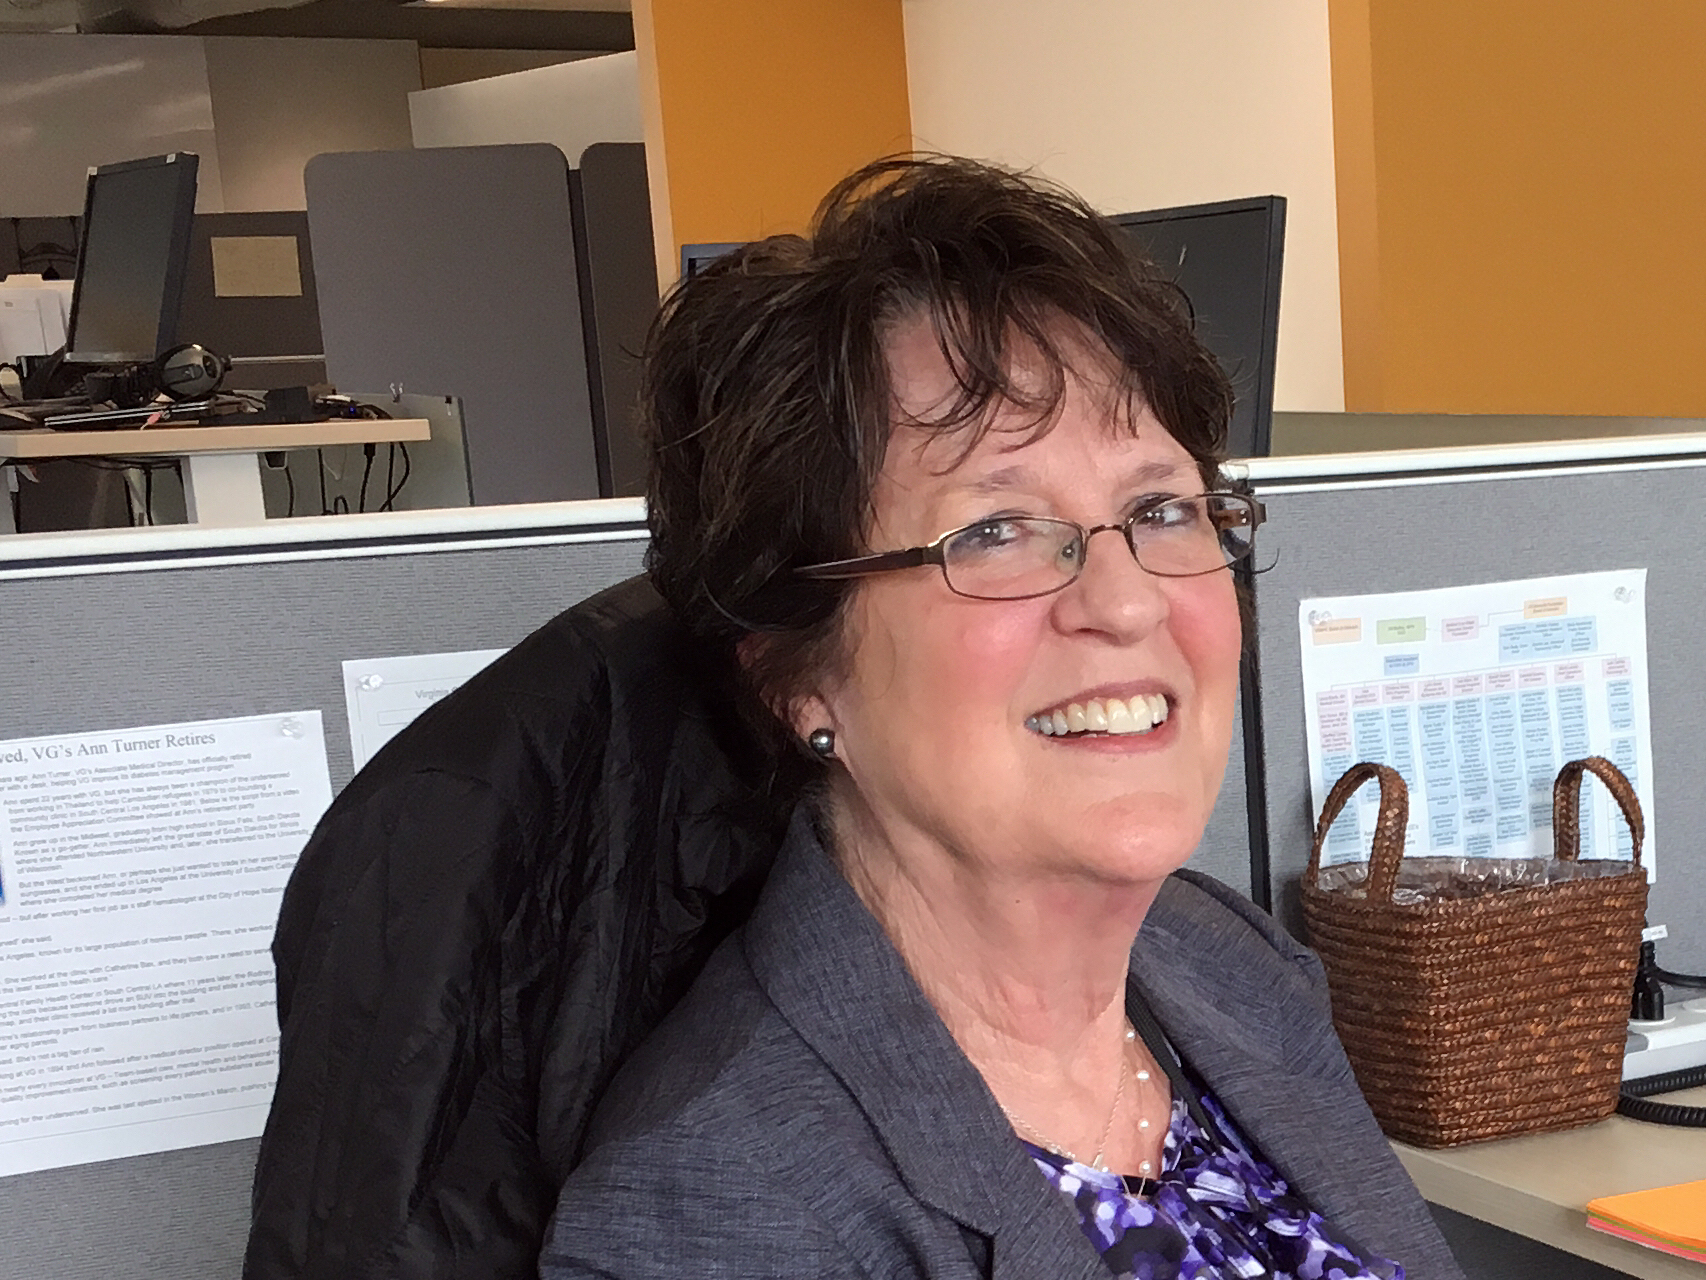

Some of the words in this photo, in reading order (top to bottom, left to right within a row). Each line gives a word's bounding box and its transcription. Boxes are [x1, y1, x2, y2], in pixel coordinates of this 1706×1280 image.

[32, 745, 72, 760] VG's
[77, 743, 108, 756] Ann
[111, 738, 161, 753] Turner
[165, 732, 216, 748] Retires
